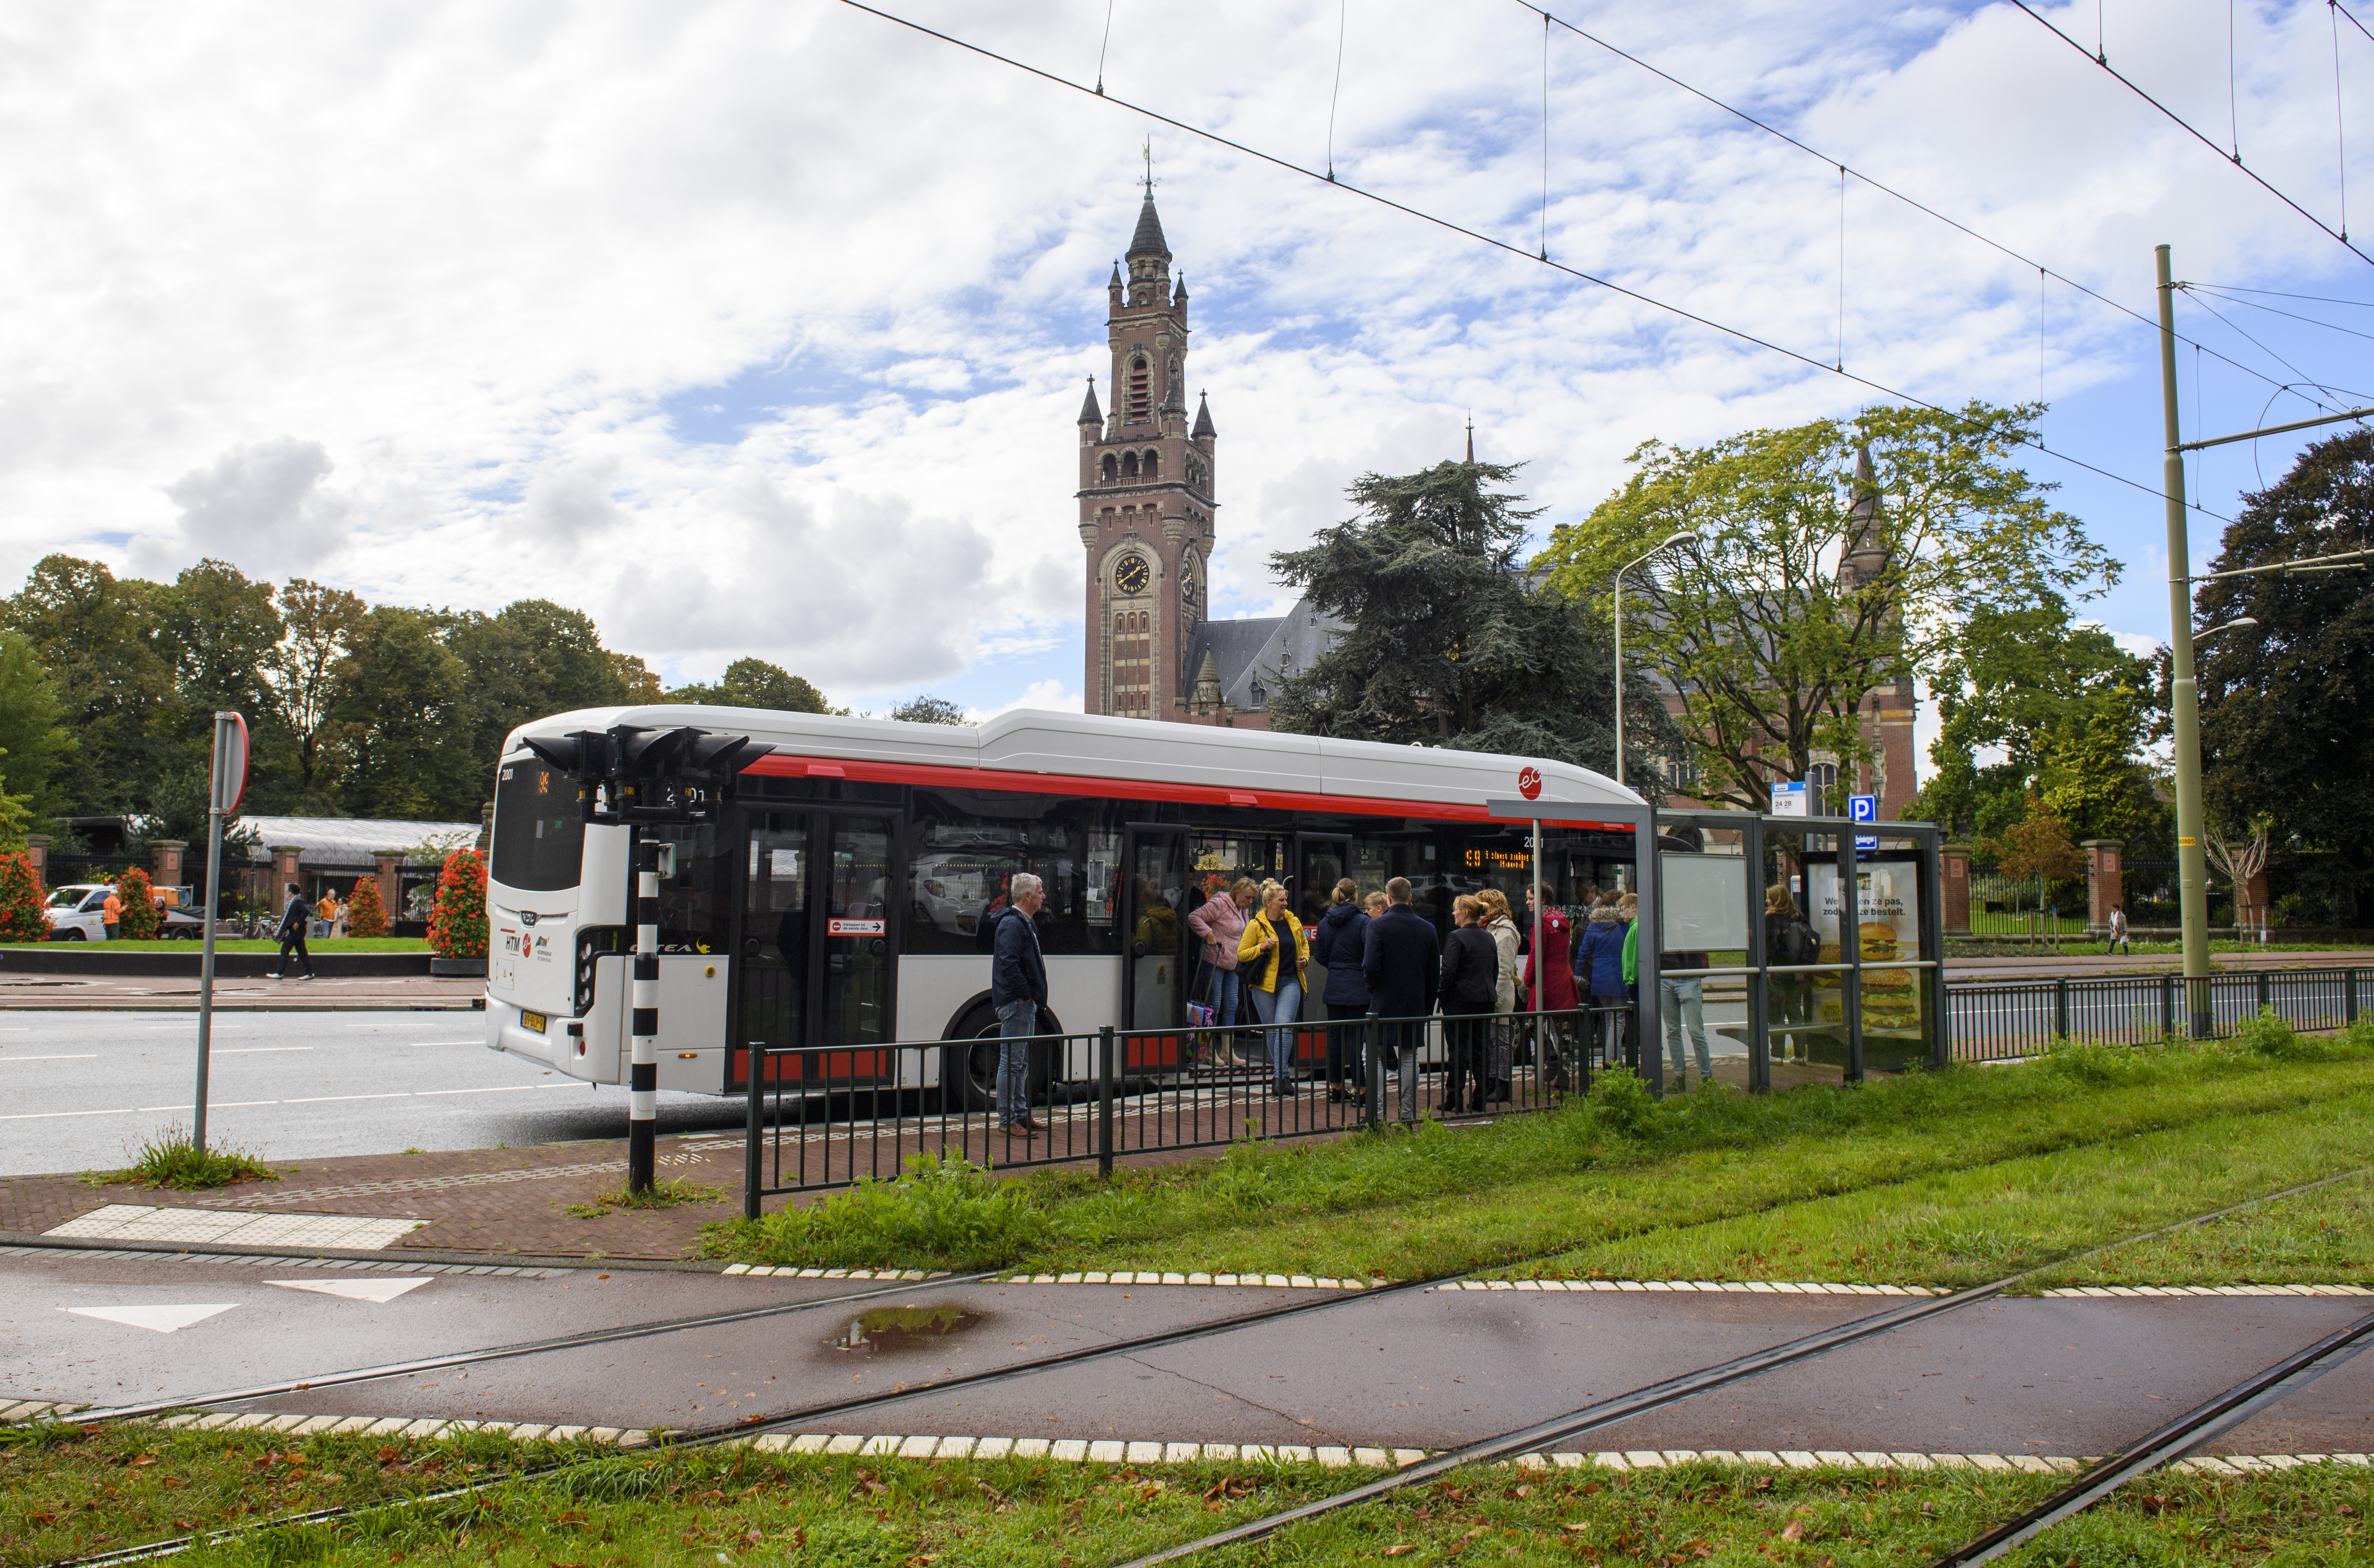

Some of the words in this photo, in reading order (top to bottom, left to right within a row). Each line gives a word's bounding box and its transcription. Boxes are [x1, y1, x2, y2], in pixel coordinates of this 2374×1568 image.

[502, 768, 513, 781] 2001
[1855, 800, 1869, 821] P
[1524, 836, 1543, 848] 201
[506, 935, 520, 952] HTM
